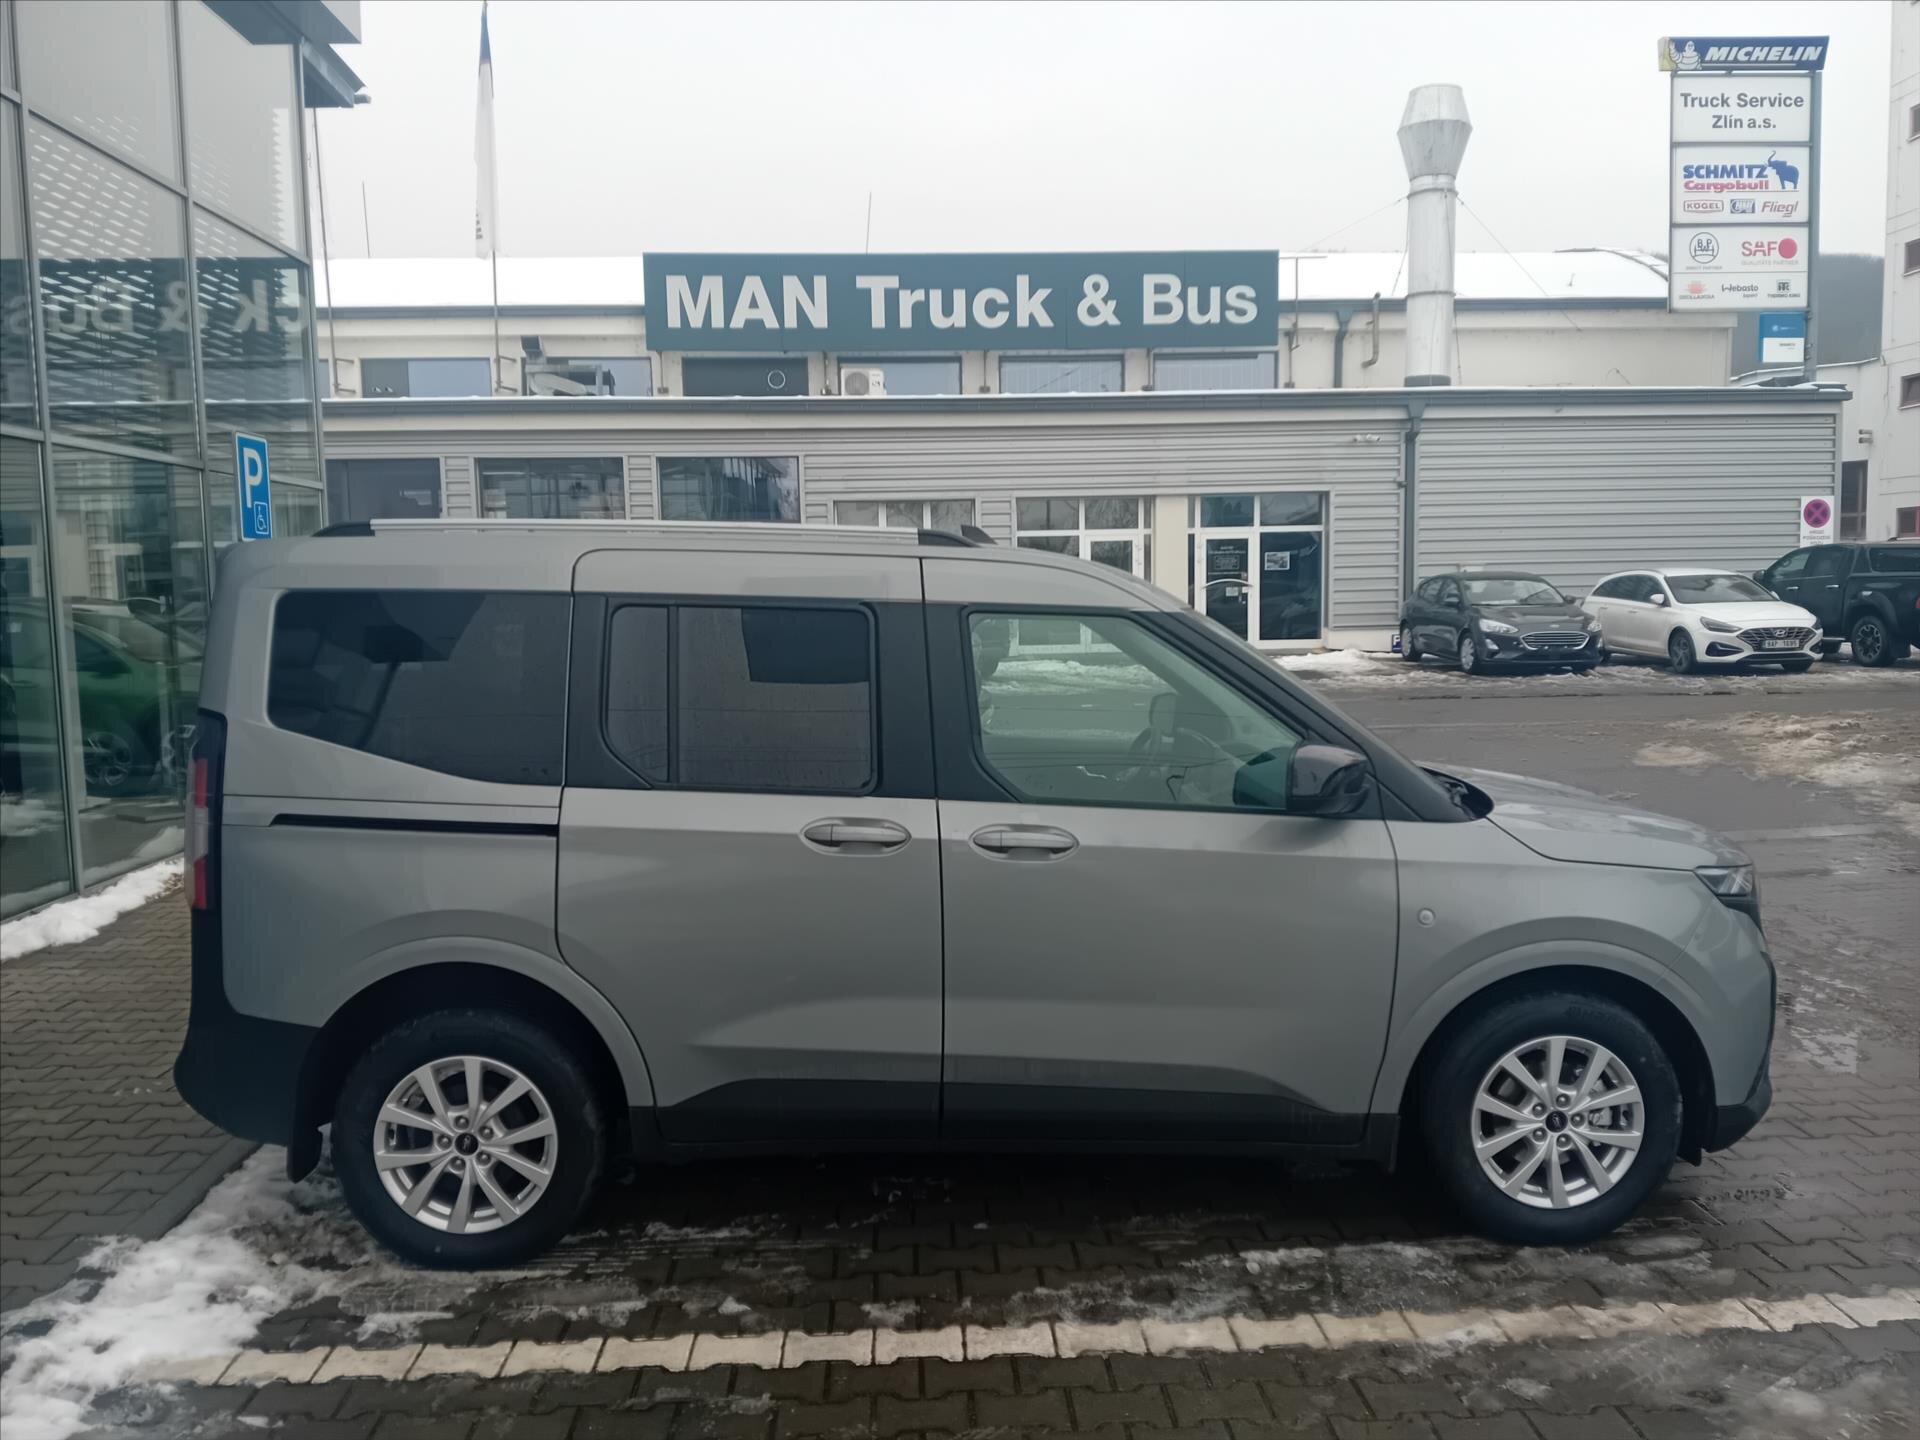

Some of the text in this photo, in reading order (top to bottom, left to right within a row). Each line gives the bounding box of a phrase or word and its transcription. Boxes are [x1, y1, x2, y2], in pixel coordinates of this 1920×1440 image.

[1704, 46, 1823, 61] MICHELIN
[1680, 93, 1804, 108] Truck Service
[1711, 114, 1777, 129] Zlín a.s.
[1683, 164, 1769, 179] SCHMITZ
[1683, 180, 1769, 193] Cargobull
[1761, 201, 1799, 214] Fliegl
[1722, 284, 1759, 292] Webasto
[665, 273, 1258, 329] MAN Truck & Bus
[243, 447, 262, 508] P
